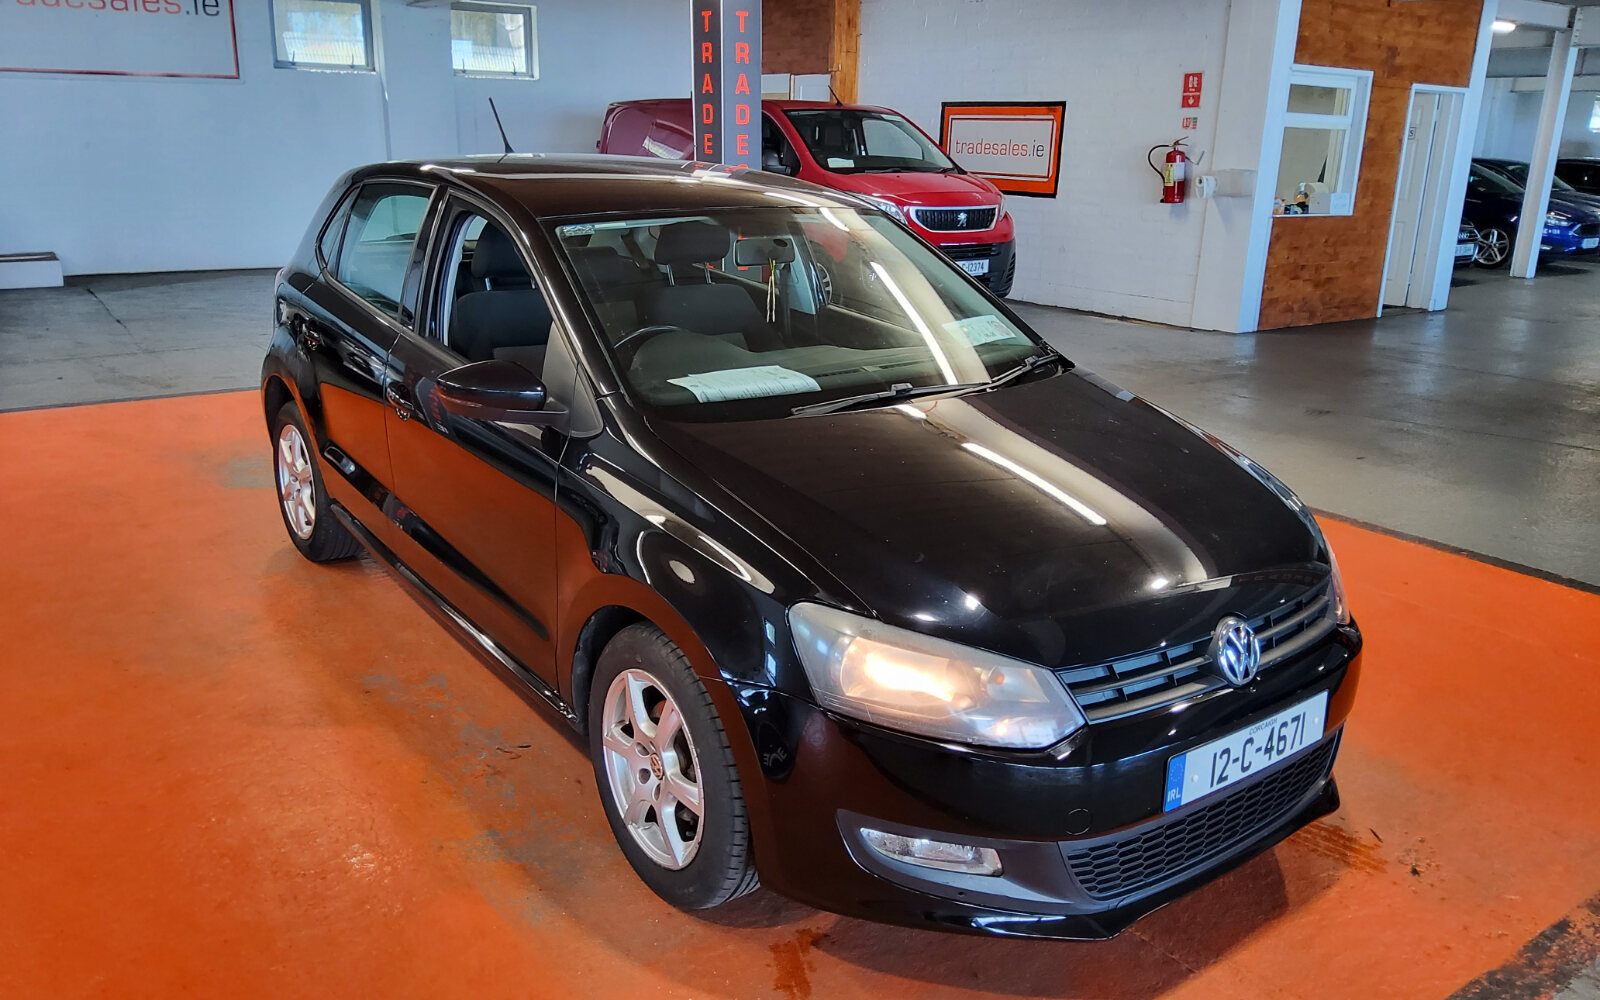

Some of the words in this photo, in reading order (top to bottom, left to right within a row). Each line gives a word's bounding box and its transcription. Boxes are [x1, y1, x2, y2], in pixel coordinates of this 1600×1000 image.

[701, 10, 714, 155] TRADE
[735, 10, 750, 169] TRADE
[955, 138, 1045, 158] tradesales.ie
[1209, 711, 1307, 789] 12-C-4671
[1167, 786, 1182, 803] IRL
